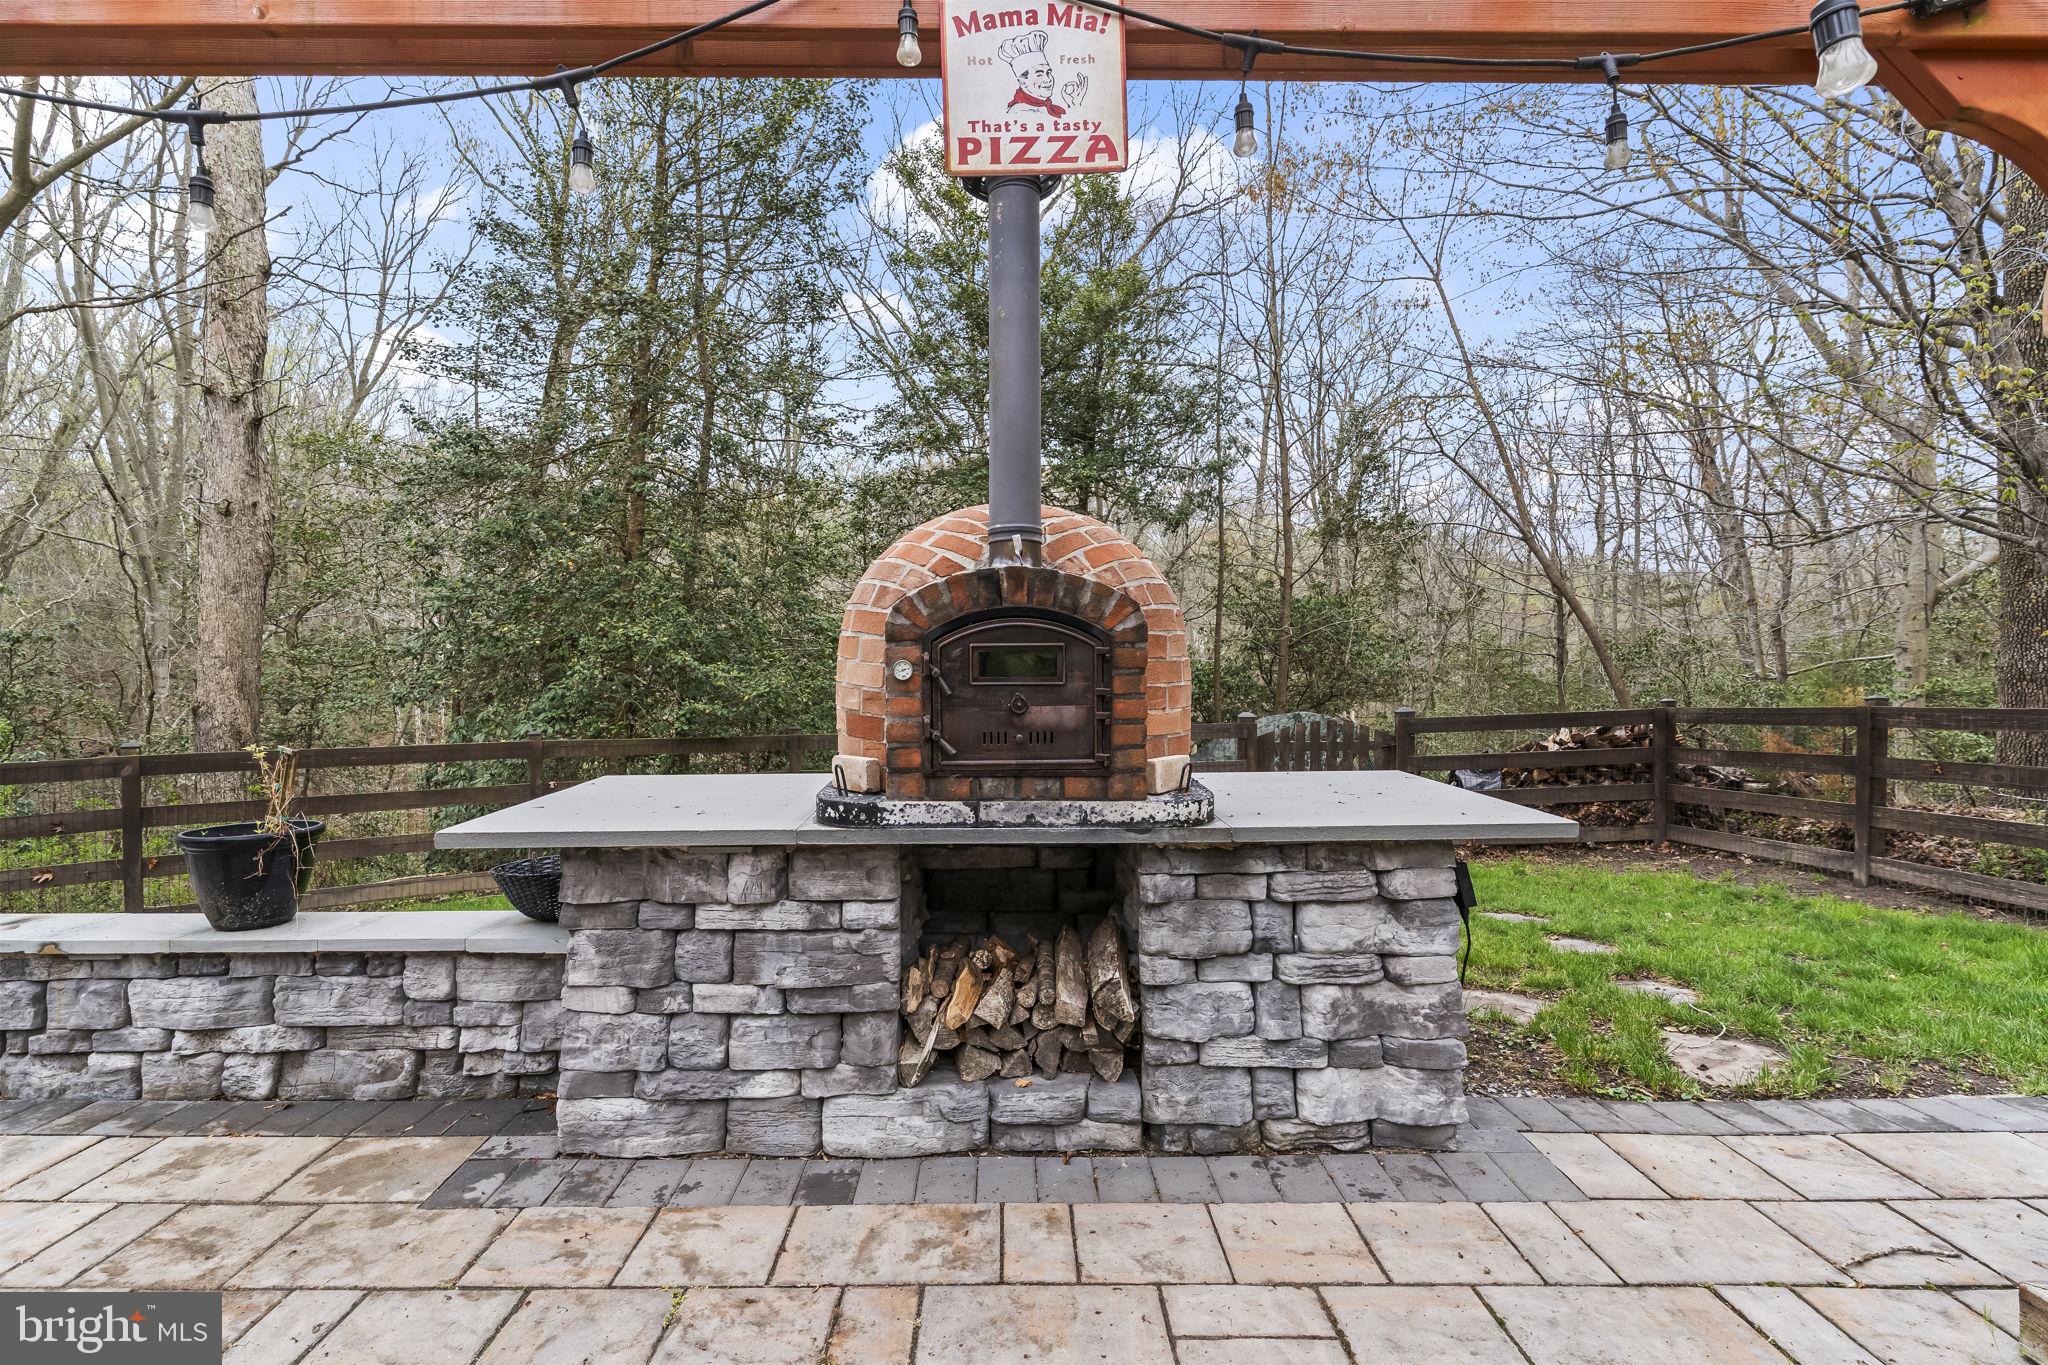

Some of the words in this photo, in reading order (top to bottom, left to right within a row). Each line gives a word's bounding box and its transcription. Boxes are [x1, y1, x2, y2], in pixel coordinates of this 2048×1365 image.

[952, 8, 1039, 38] Mama
[1047, 3, 1111, 35] Mia!
[967, 56, 993, 66] Hot
[1059, 54, 1096, 65] Fresh
[967, 120, 1028, 133] That's
[1036, 123, 1045, 132] a
[1053, 120, 1102, 133] tasty
[957, 135, 1119, 166] PIZZA
